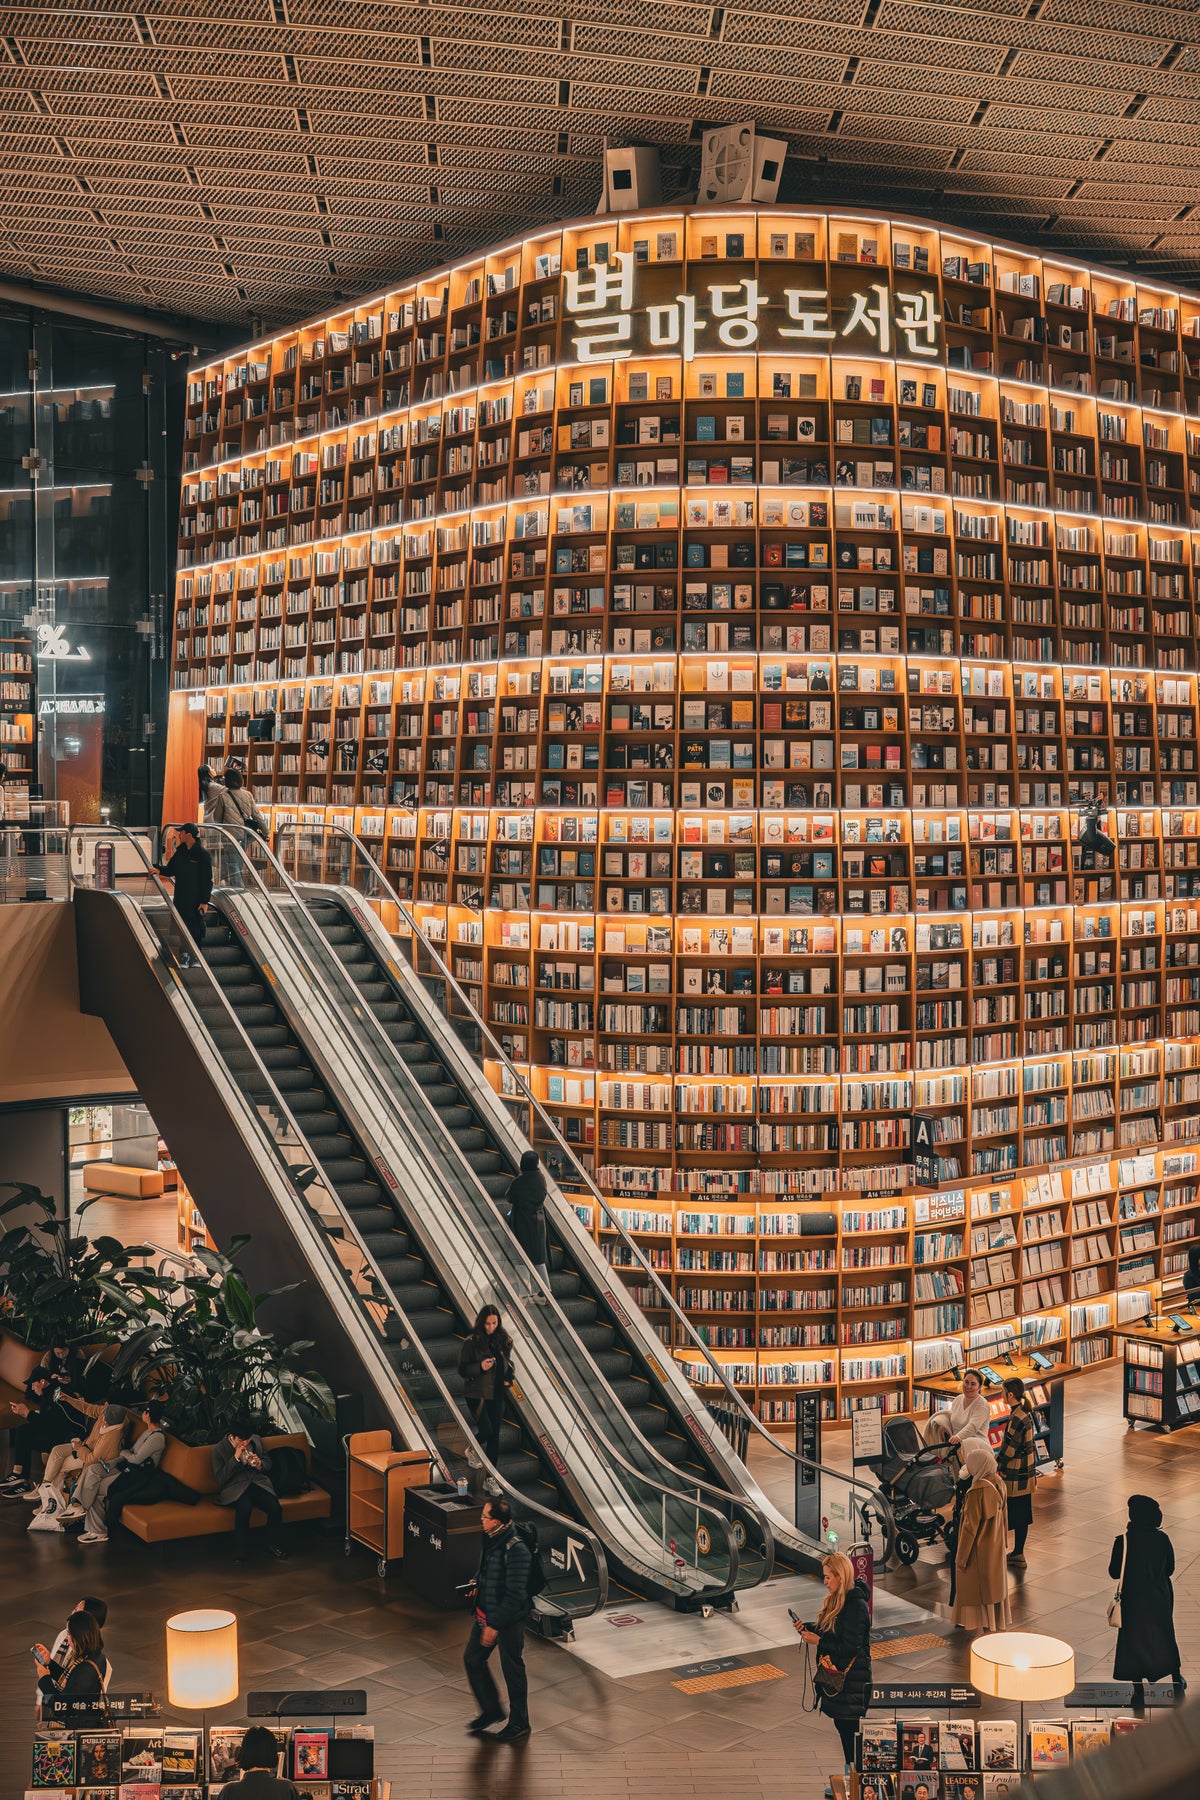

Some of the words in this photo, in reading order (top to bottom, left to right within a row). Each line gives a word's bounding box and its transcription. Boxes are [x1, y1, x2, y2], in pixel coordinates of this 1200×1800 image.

[561, 251, 769, 362] 별마당
[778, 284, 942, 356] 도서관
[916, 1121, 929, 1145] A
[930, 1193, 964, 1208] 비즈니스
[930, 1205, 964, 1220] 라이브러리
[872, 1690, 884, 1699] D1
[54, 1702, 67, 1711] D2
[148, 1740, 161, 1748] Art
[945, 1777, 979, 1785] LEADERS
[338, 1784, 370, 1794] Strad
